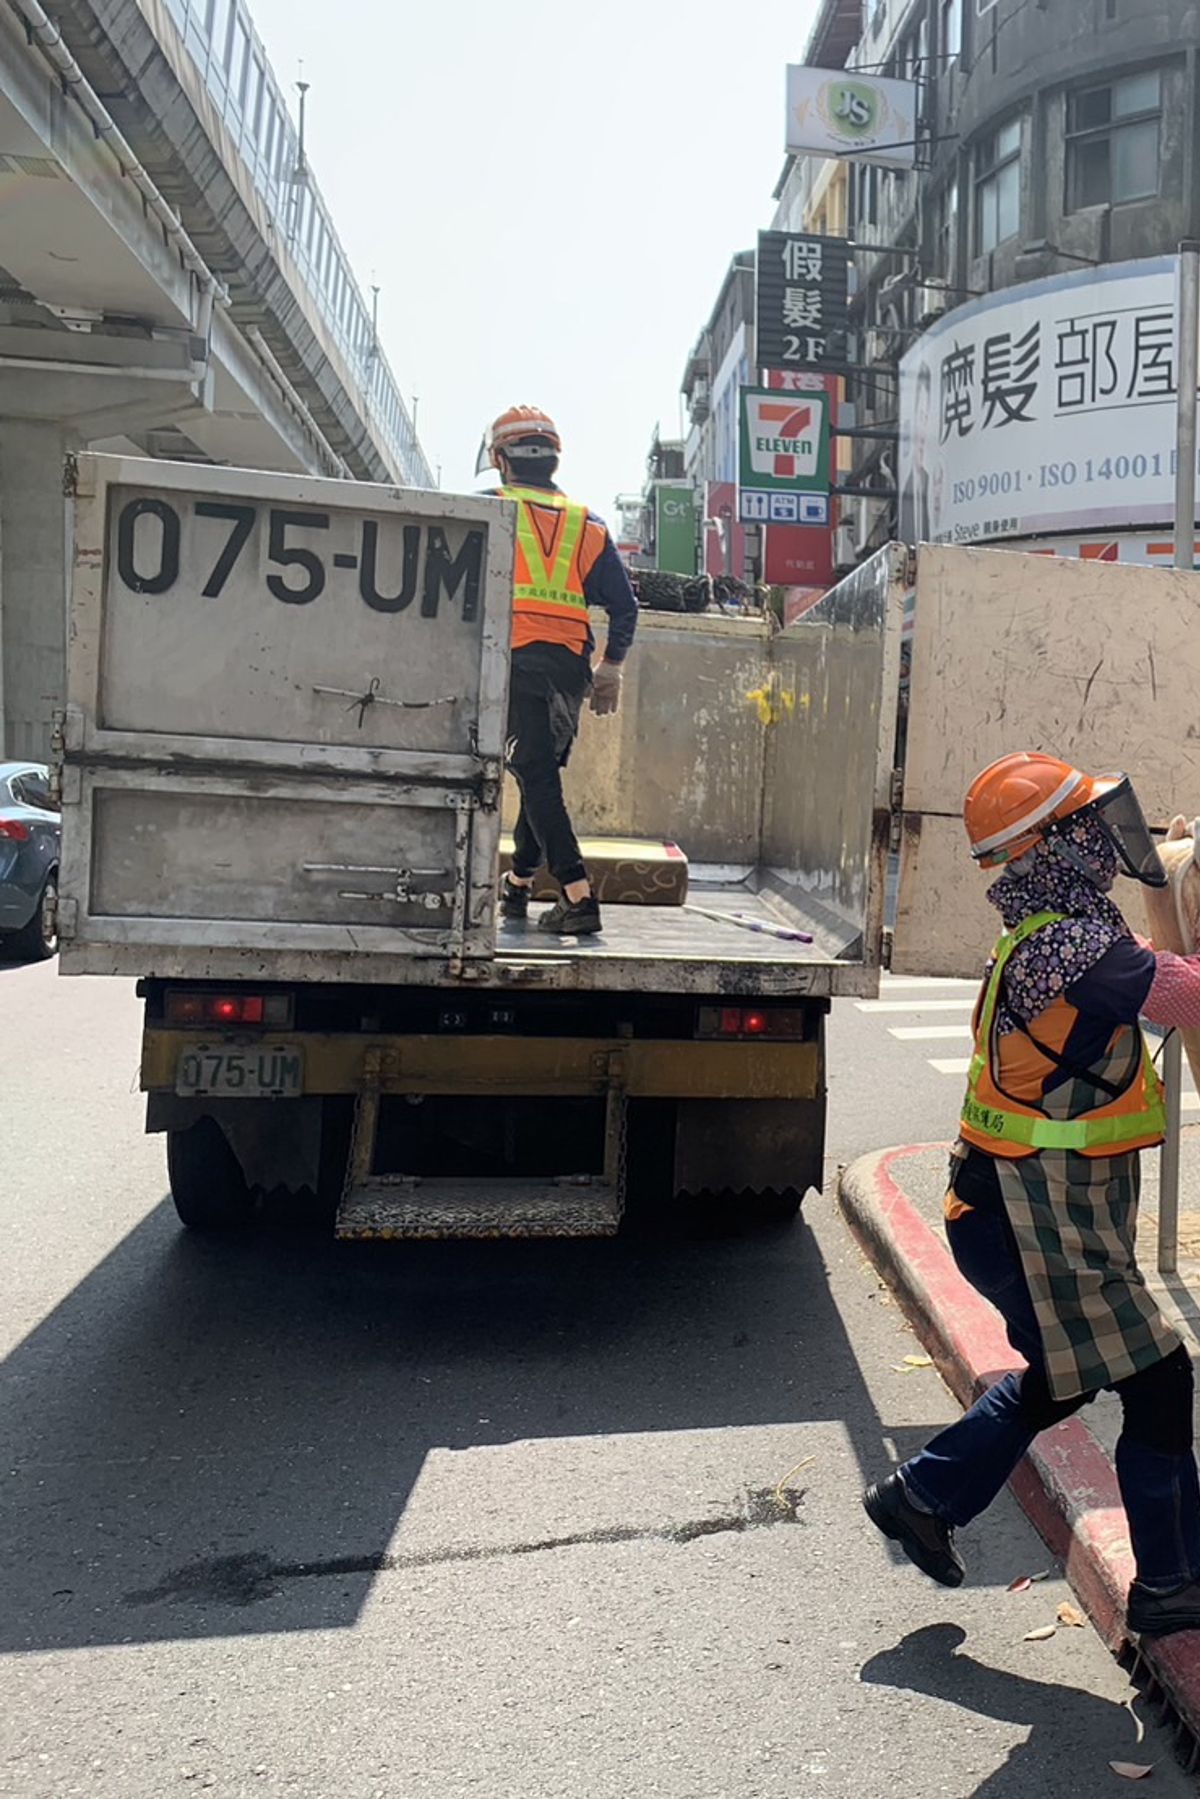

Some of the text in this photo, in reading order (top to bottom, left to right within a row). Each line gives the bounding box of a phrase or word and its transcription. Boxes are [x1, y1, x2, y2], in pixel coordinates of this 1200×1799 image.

[781, 239, 824, 331] 假髮
[782, 335, 827, 363] 2F
[758, 403, 811, 476] 7
[952, 478, 975, 505] ISO
[978, 470, 1022, 498] 9001
[1039, 461, 1077, 488] ISO
[1084, 453, 1162, 482] 14001
[117, 498, 487, 623] 075-UM
[182, 1055, 301, 1089] 075-UM
